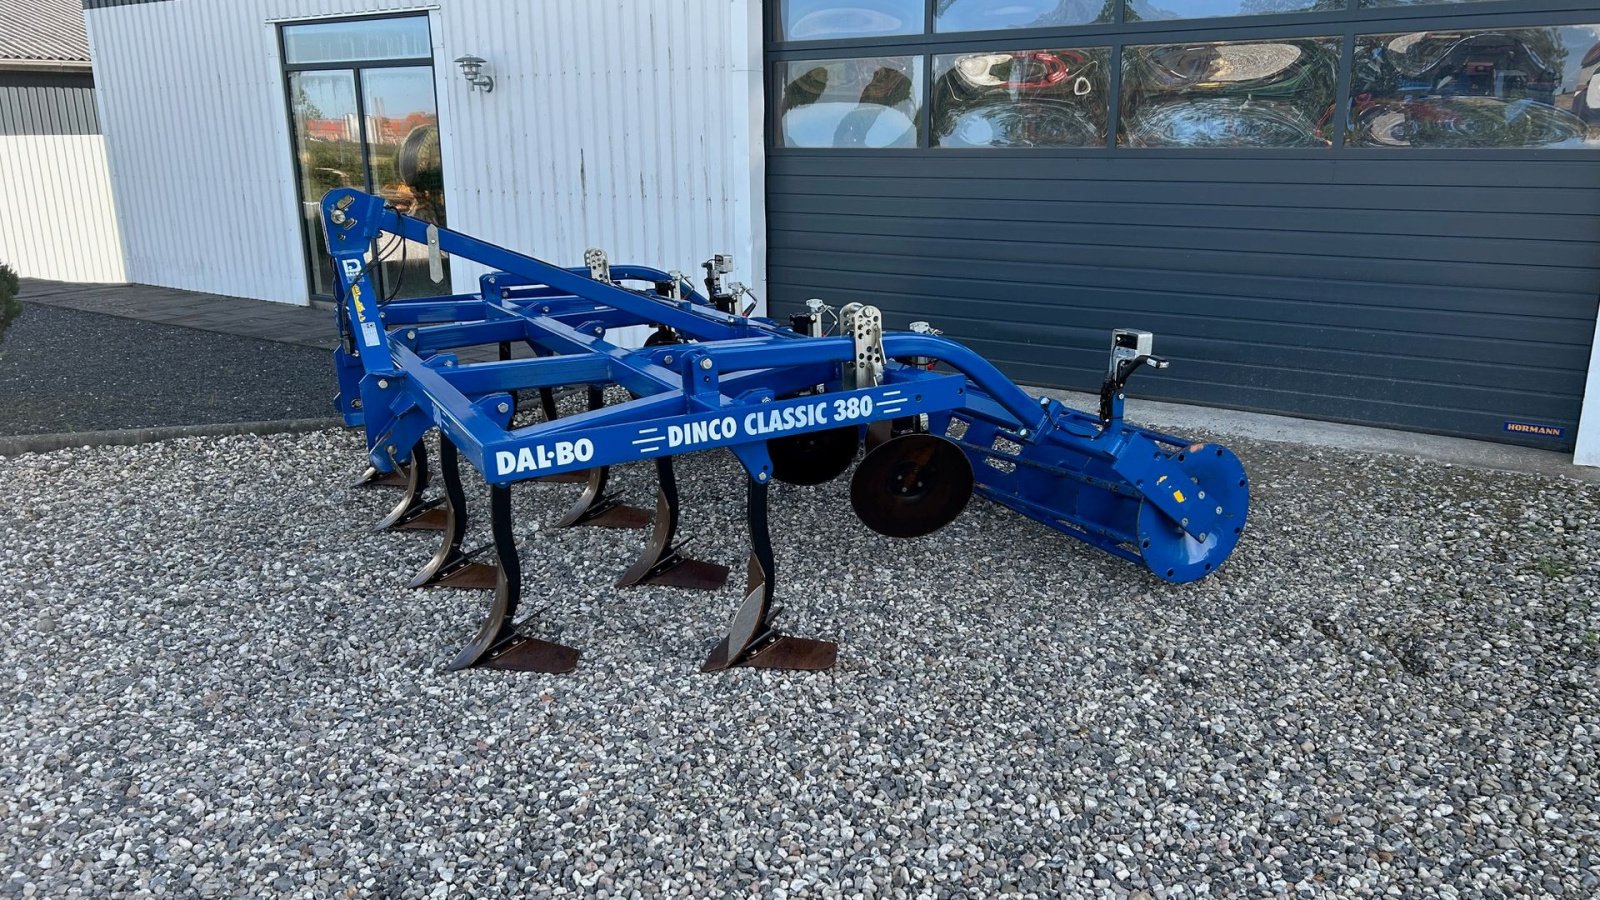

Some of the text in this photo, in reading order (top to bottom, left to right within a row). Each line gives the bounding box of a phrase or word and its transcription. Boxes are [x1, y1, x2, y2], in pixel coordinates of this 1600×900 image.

[668, 416, 737, 447] DINCO
[744, 402, 827, 435] CLASSIC
[833, 395, 873, 421] 380
